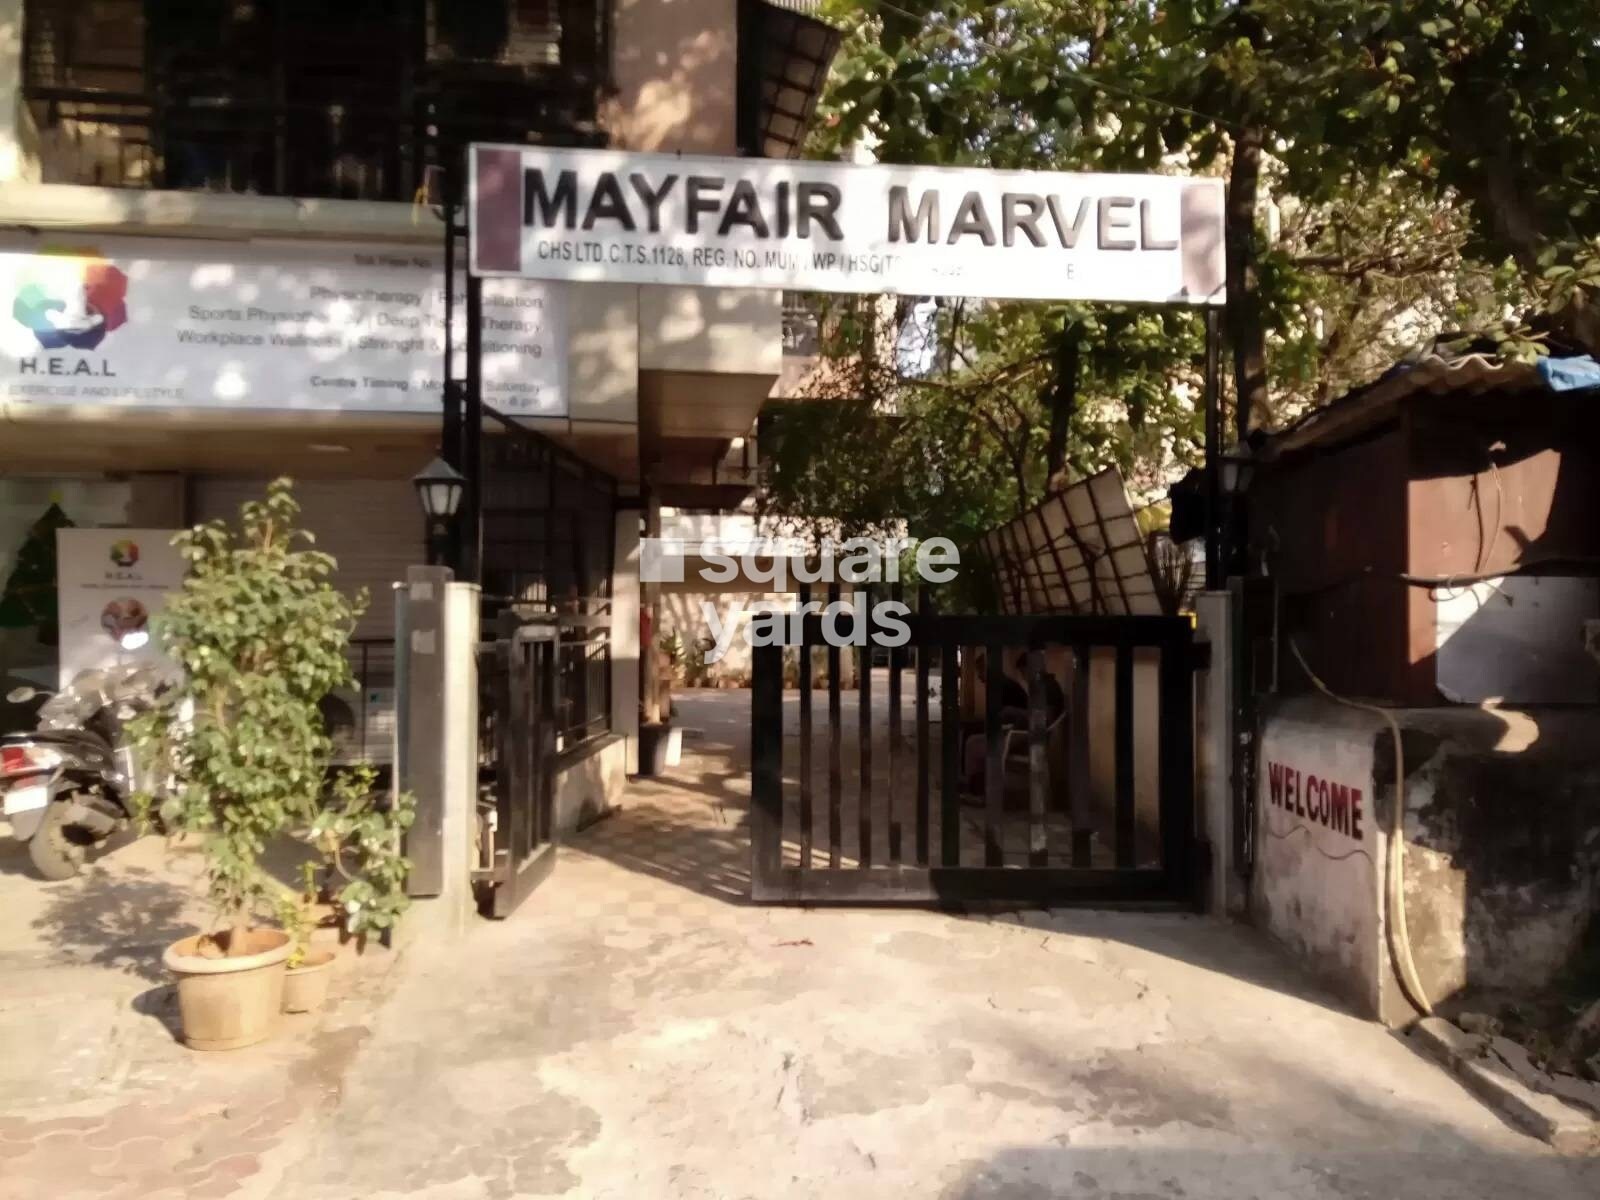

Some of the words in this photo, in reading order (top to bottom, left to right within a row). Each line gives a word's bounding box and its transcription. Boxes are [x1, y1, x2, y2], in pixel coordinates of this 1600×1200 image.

[523, 167, 843, 241] MAYFAIR
[888, 185, 1179, 251] MARVEL
[538, 240, 572, 261] CHS
[1268, 761, 1363, 841] WELCOME
